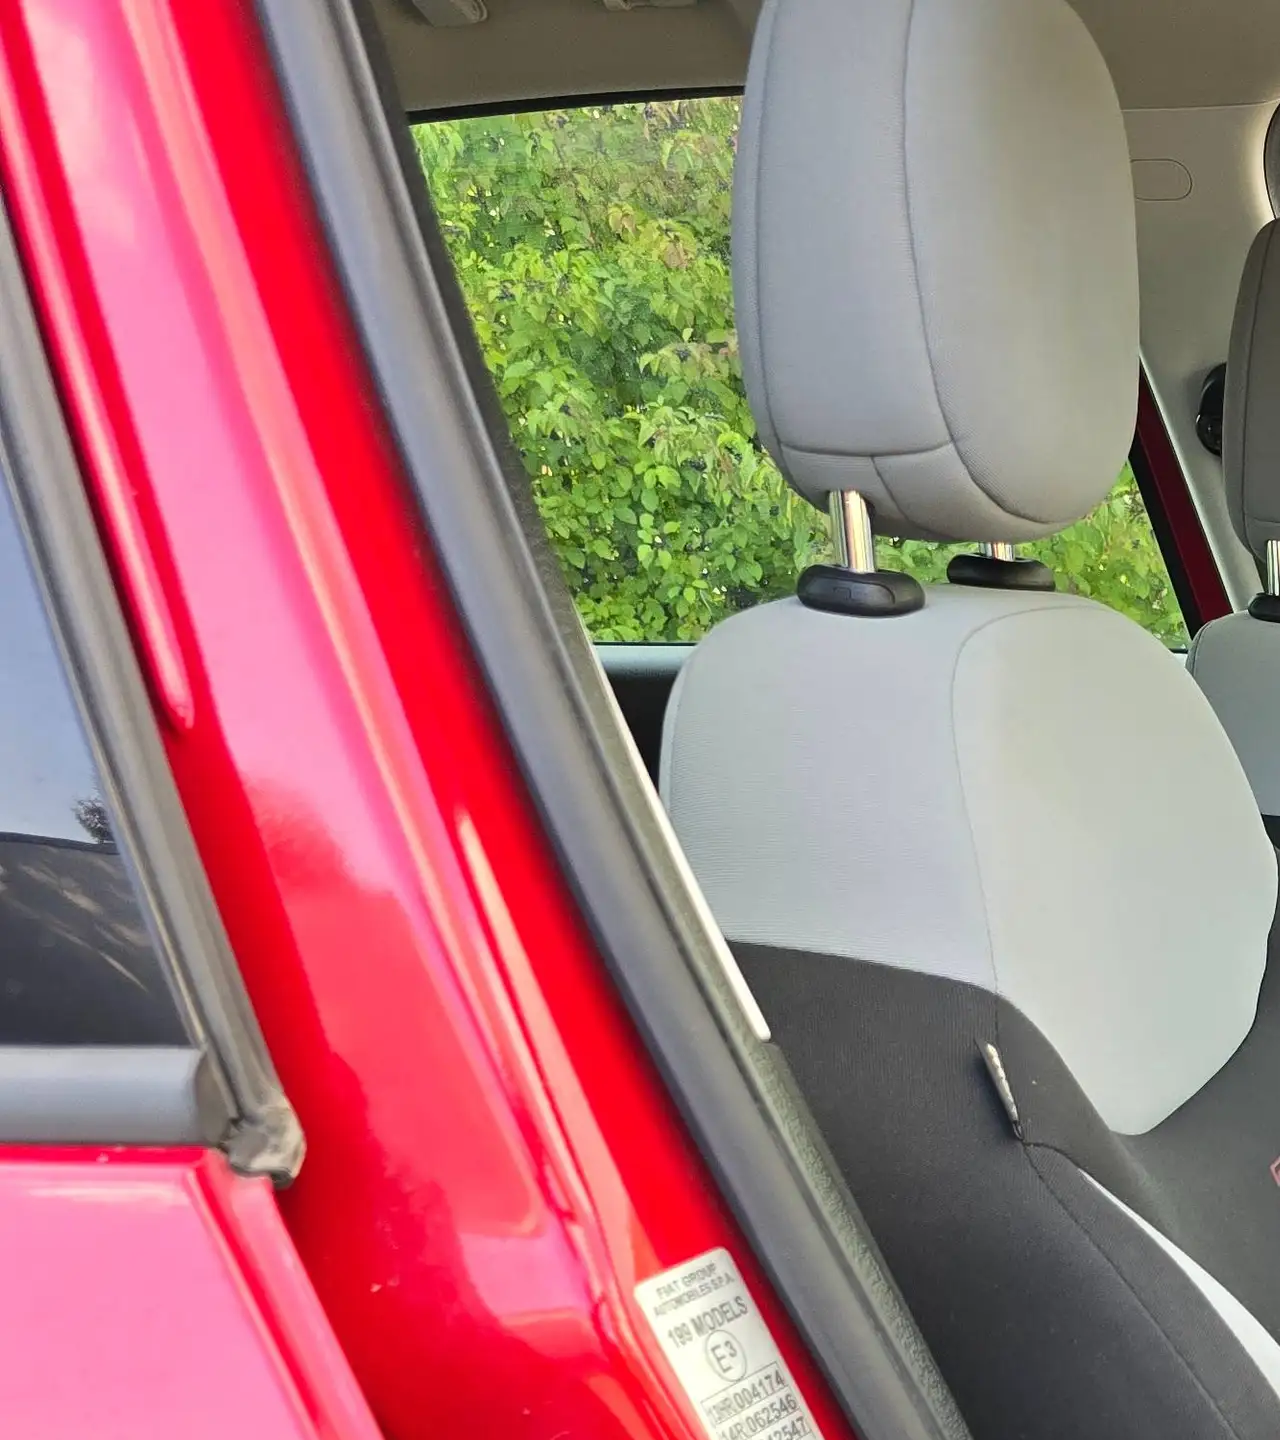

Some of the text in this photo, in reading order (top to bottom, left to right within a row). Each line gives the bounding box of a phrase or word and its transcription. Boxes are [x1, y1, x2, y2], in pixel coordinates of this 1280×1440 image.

[656, 1262, 716, 1299] FIAT GROUP
[668, 1296, 748, 1348] 199 MODELS
[733, 1370, 785, 1409] 004174
[745, 1393, 797, 1433] 062546
